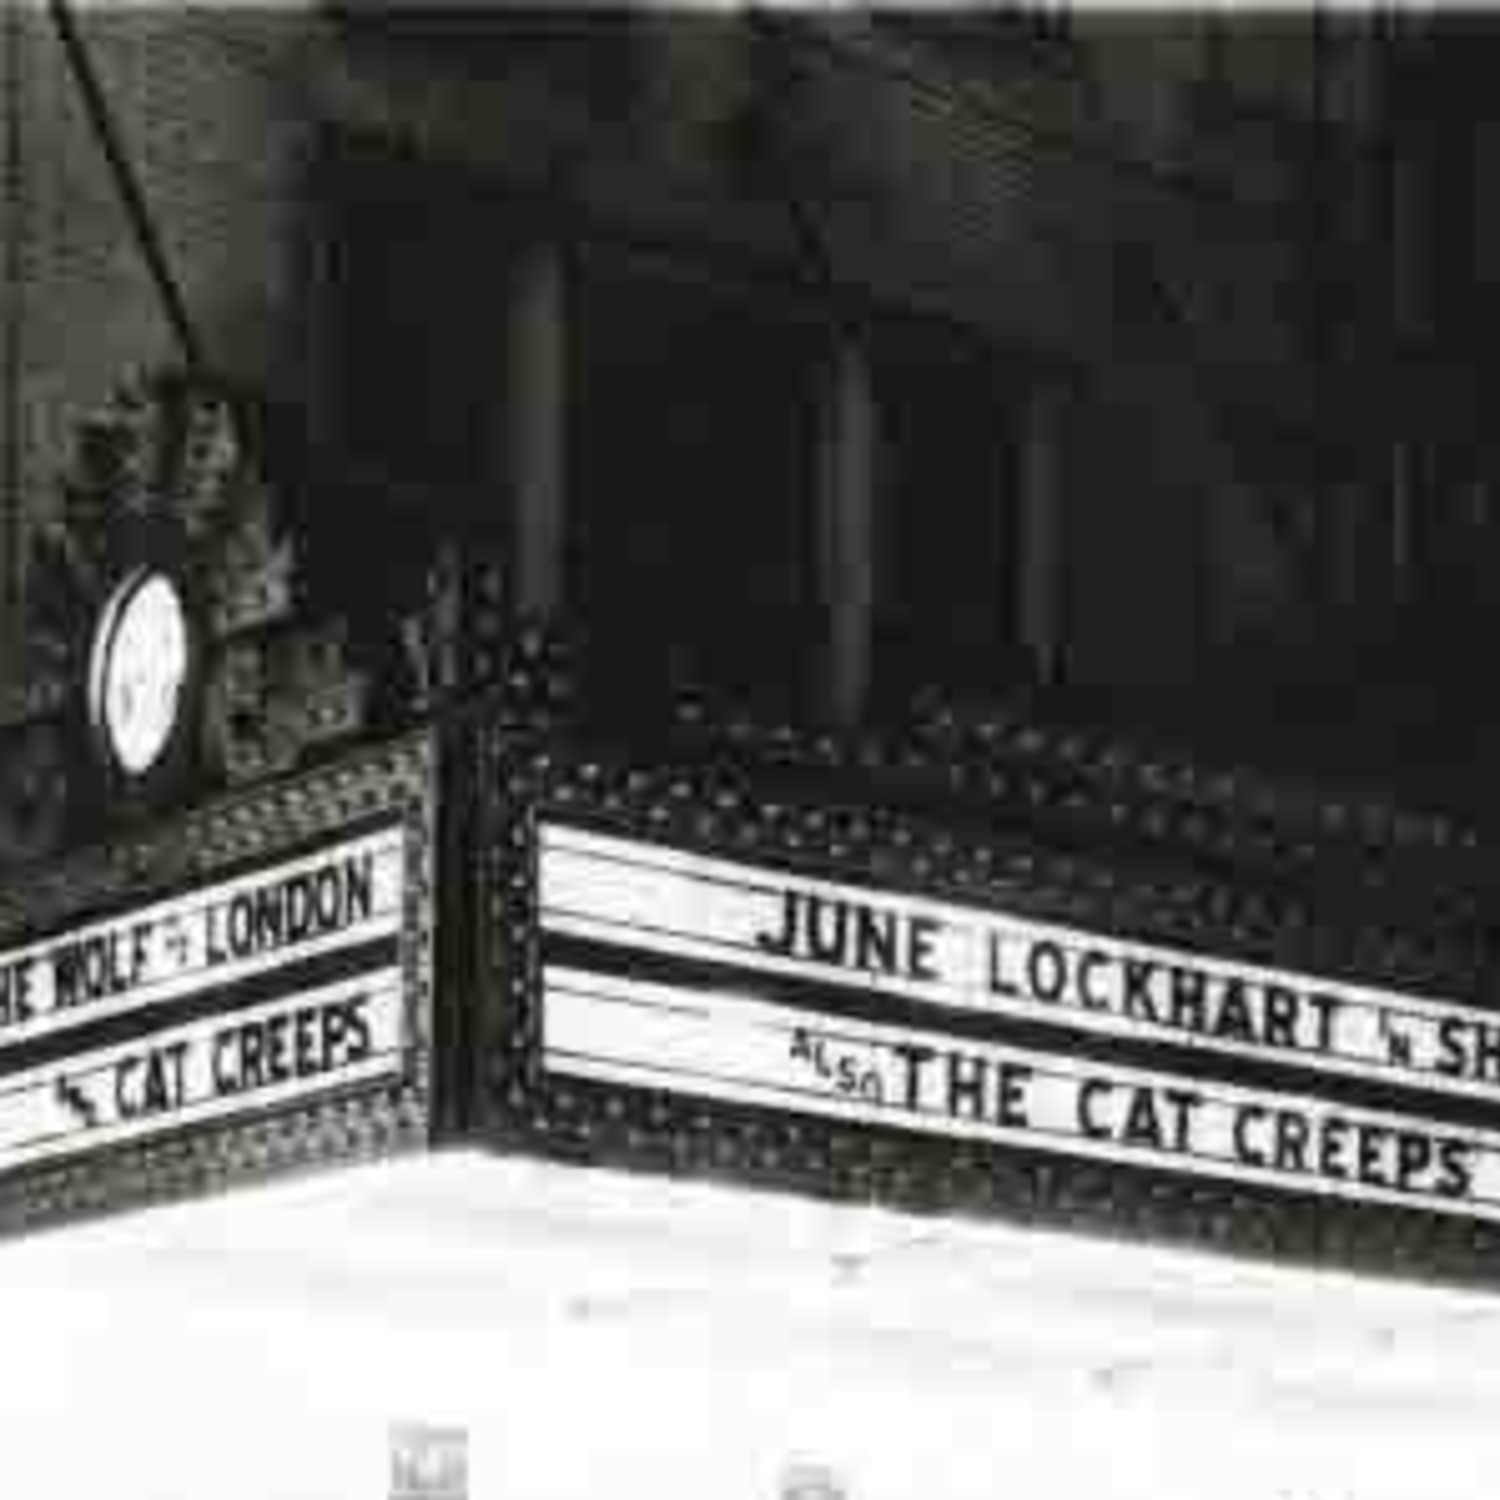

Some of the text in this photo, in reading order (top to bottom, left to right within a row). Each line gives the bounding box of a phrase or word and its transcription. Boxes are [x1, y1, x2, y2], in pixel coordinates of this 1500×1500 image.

[204, 852, 374, 966] LONDON
[755, 888, 942, 982] JUNE
[989, 930, 1336, 1052] LOCKHART
[114, 1041, 187, 1120] CAT
[212, 996, 370, 1097] CREEPS
[893, 1046, 1033, 1128] THE
[1076, 1080, 1200, 1150] CAT
[1233, 1106, 1471, 1197] CREEPS
